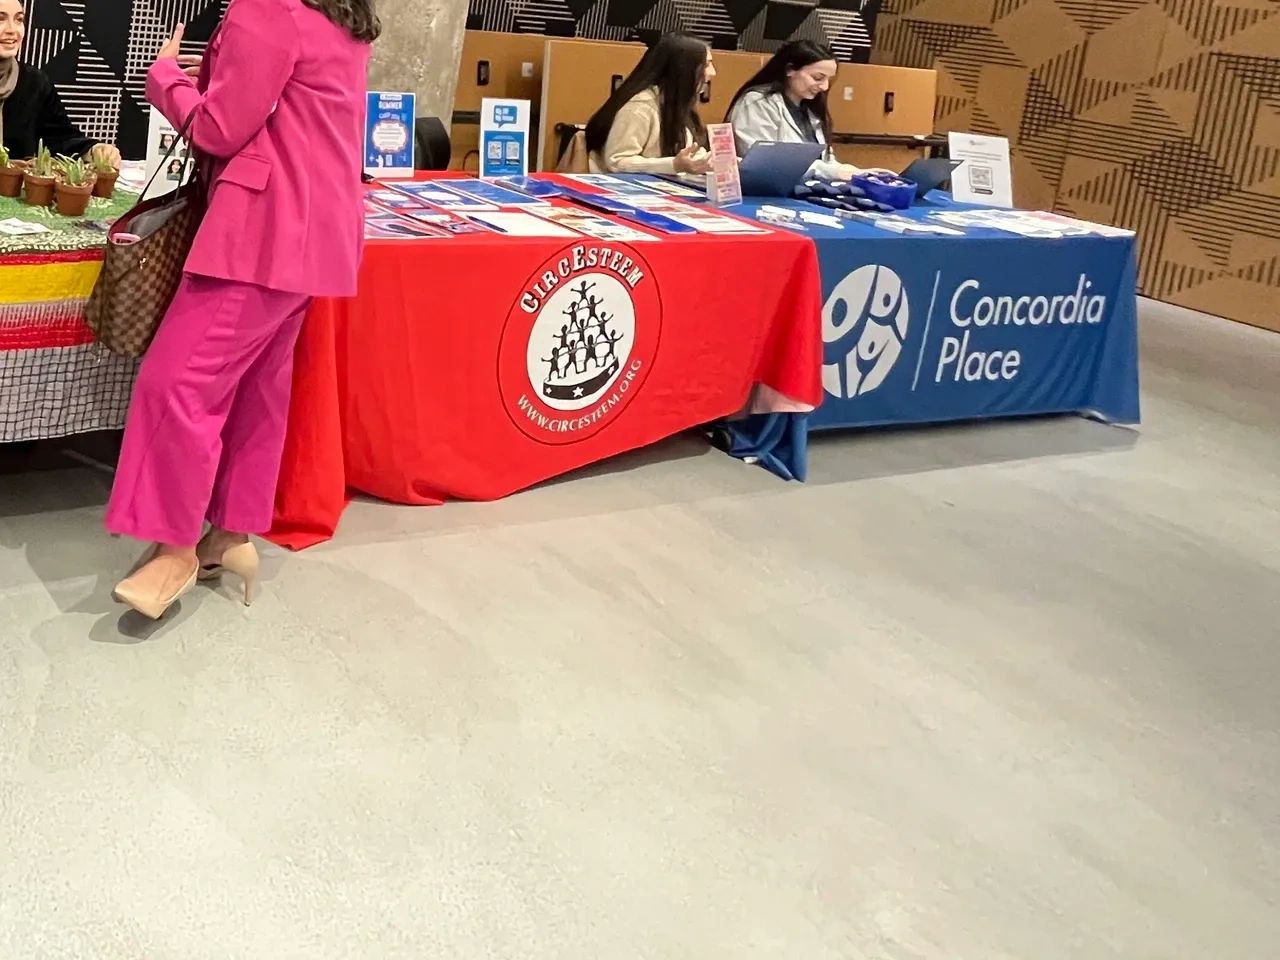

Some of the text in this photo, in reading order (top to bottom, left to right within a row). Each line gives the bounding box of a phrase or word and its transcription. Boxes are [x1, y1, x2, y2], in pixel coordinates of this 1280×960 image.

[949, 272, 1107, 328] Concordia
[935, 329, 1021, 383] Place
[517, 359, 643, 432] WWW.CIRCESTEEM.ORG
